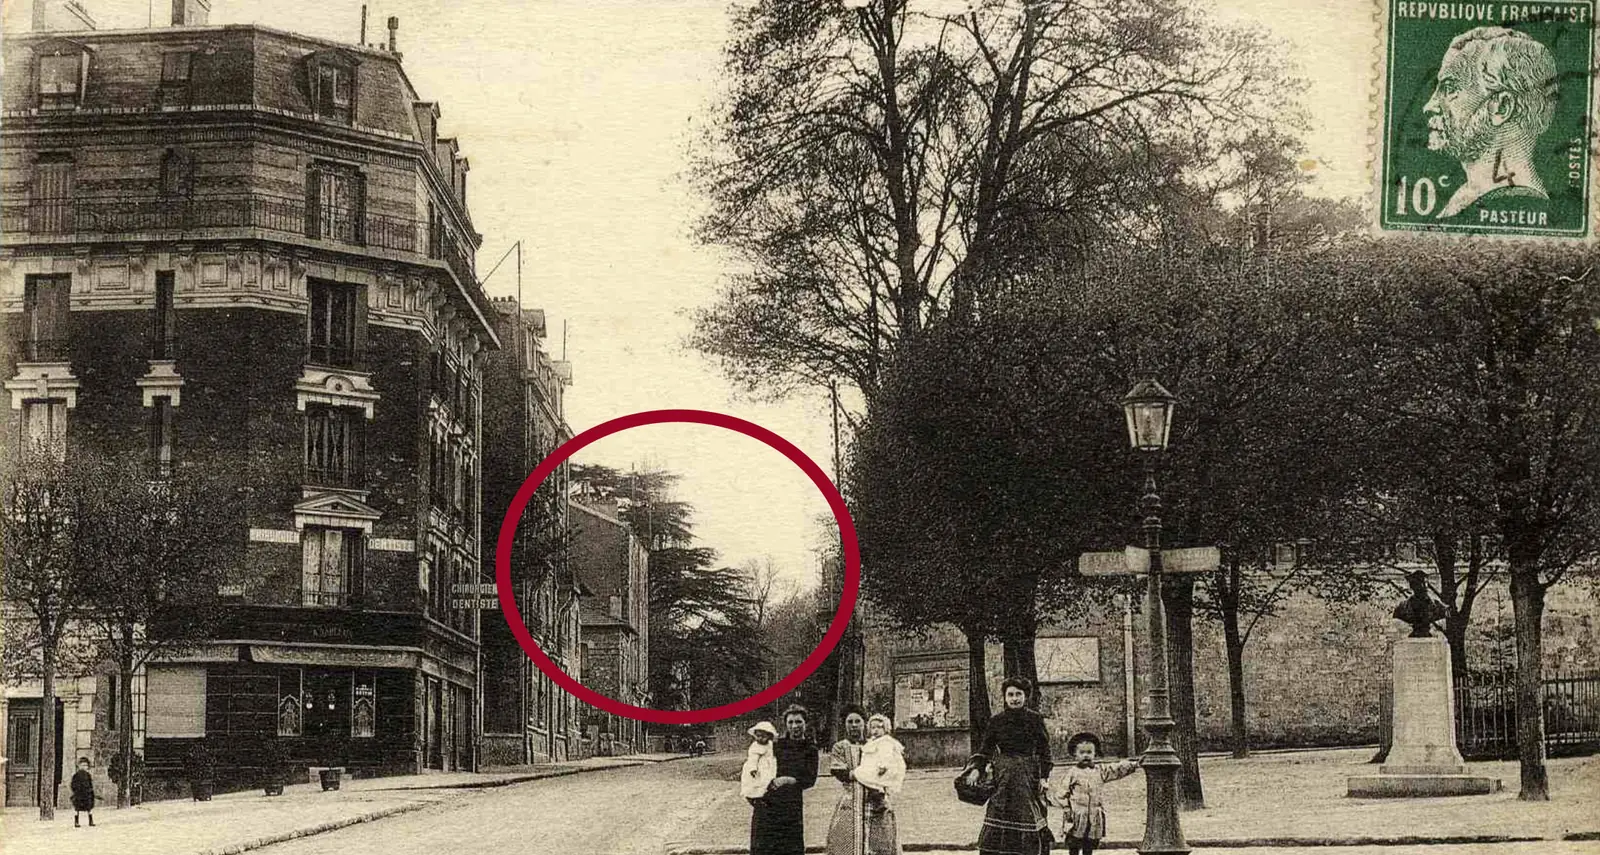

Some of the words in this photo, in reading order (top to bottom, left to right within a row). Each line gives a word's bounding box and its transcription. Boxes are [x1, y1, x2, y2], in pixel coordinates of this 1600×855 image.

[1479, 209, 1548, 226] PASTEUR
[368, 538, 415, 551] DENTISTE
[451, 583, 498, 595] CHIRURGIEN
[452, 598, 499, 609] DENTISTE
